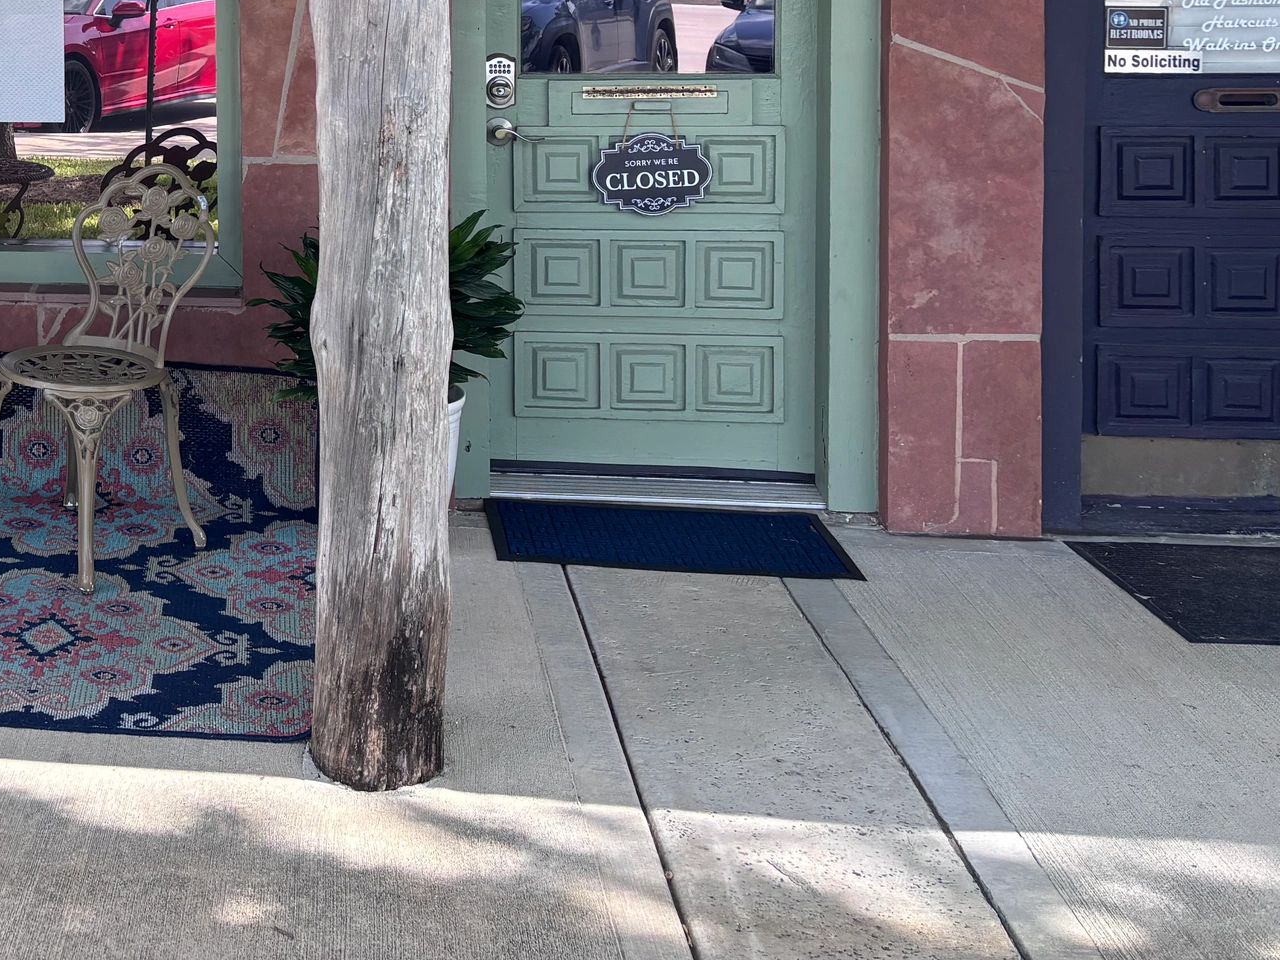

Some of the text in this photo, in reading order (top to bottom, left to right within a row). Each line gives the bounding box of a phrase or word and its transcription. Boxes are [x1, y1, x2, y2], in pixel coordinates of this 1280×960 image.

[1202, 15, 1278, 32] Haircuts
[1110, 29, 1163, 39] RESTROOMS
[1183, 37, 1256, 51] Walk-ins
[1107, 54, 1200, 71] No Soliciting
[624, 158, 679, 168] SORRY WERE
[605, 169, 700, 191] CLOSED
